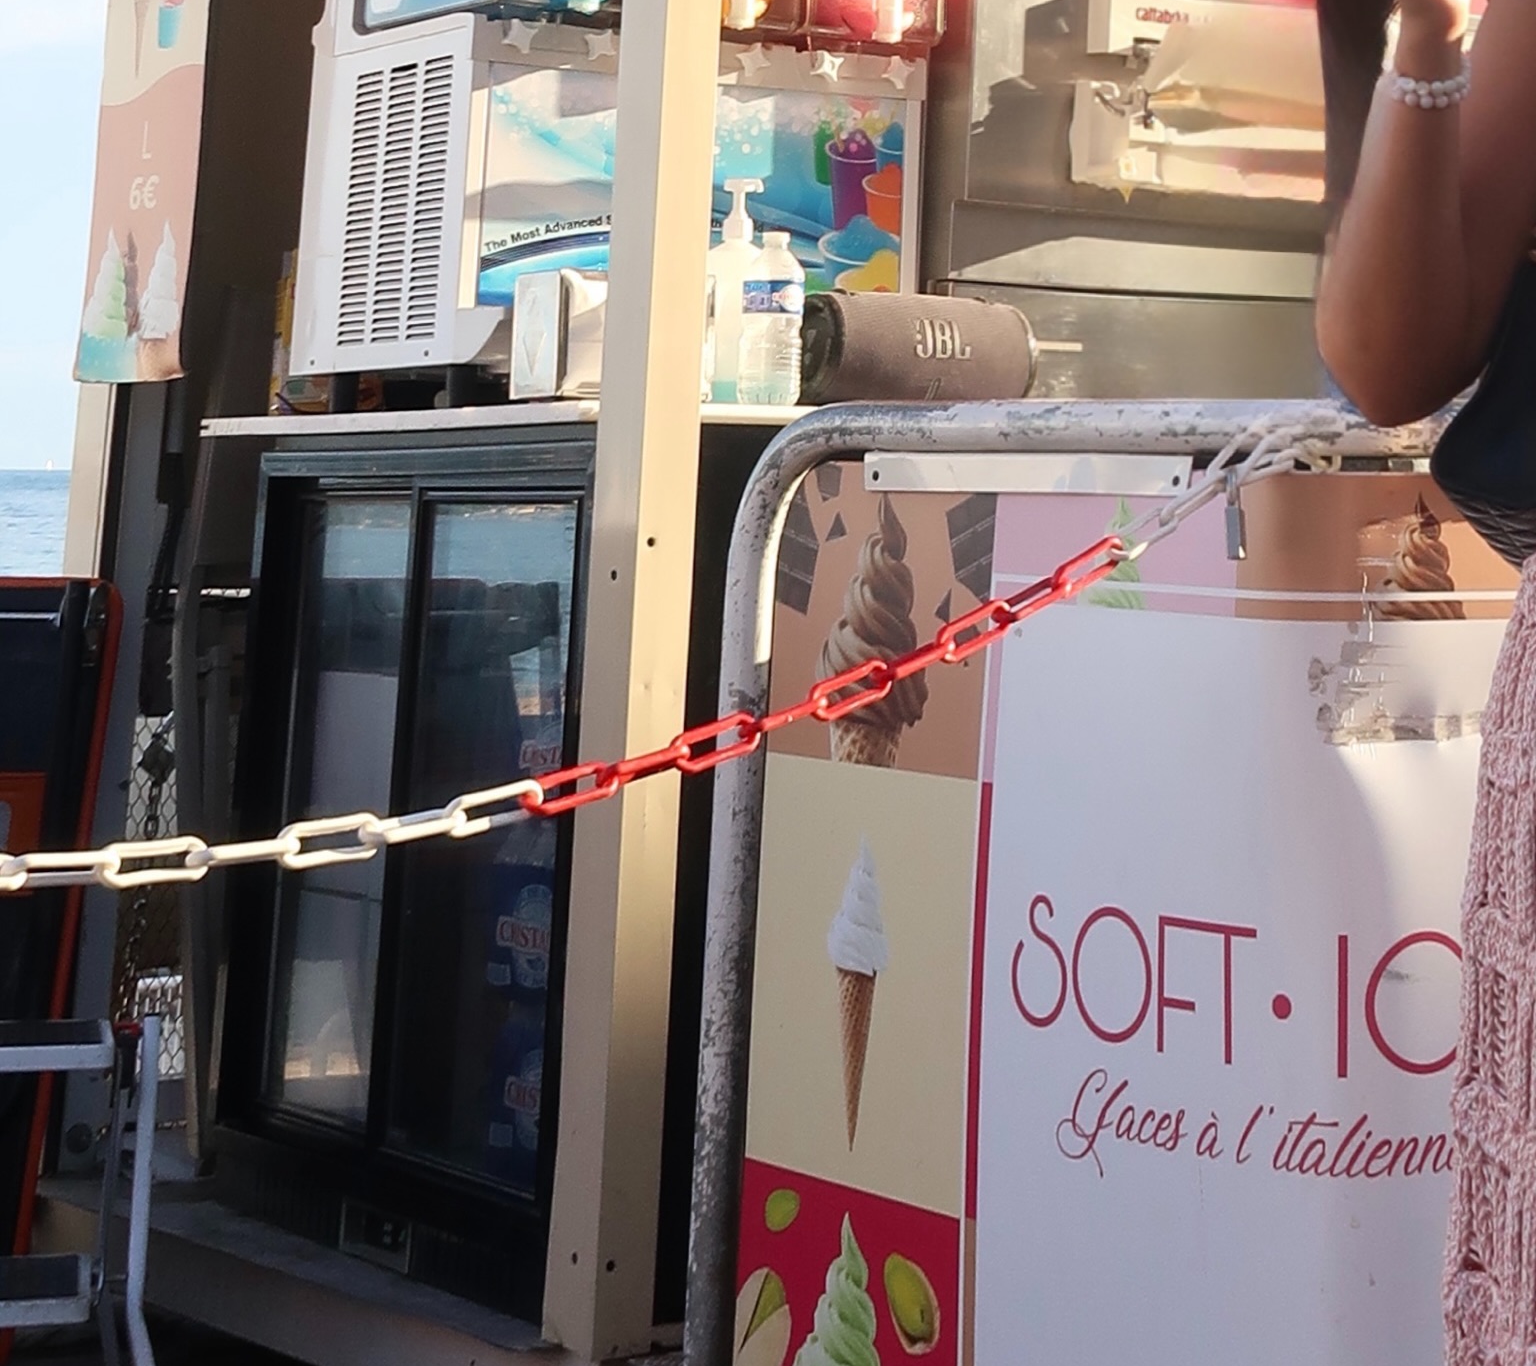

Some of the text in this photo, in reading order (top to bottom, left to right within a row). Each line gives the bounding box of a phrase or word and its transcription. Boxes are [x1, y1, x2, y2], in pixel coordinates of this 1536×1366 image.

[142, 121, 152, 160] L
[129, 174, 160, 210] 6€
[484, 239, 508, 253] The
[511, 226, 541, 244] Most
[544, 215, 603, 235] Advanced
[916, 319, 972, 361] JBL
[1011, 894, 1464, 1078] SOFT IC
[1056, 1068, 1454, 1179] Glaces à l'italienn
